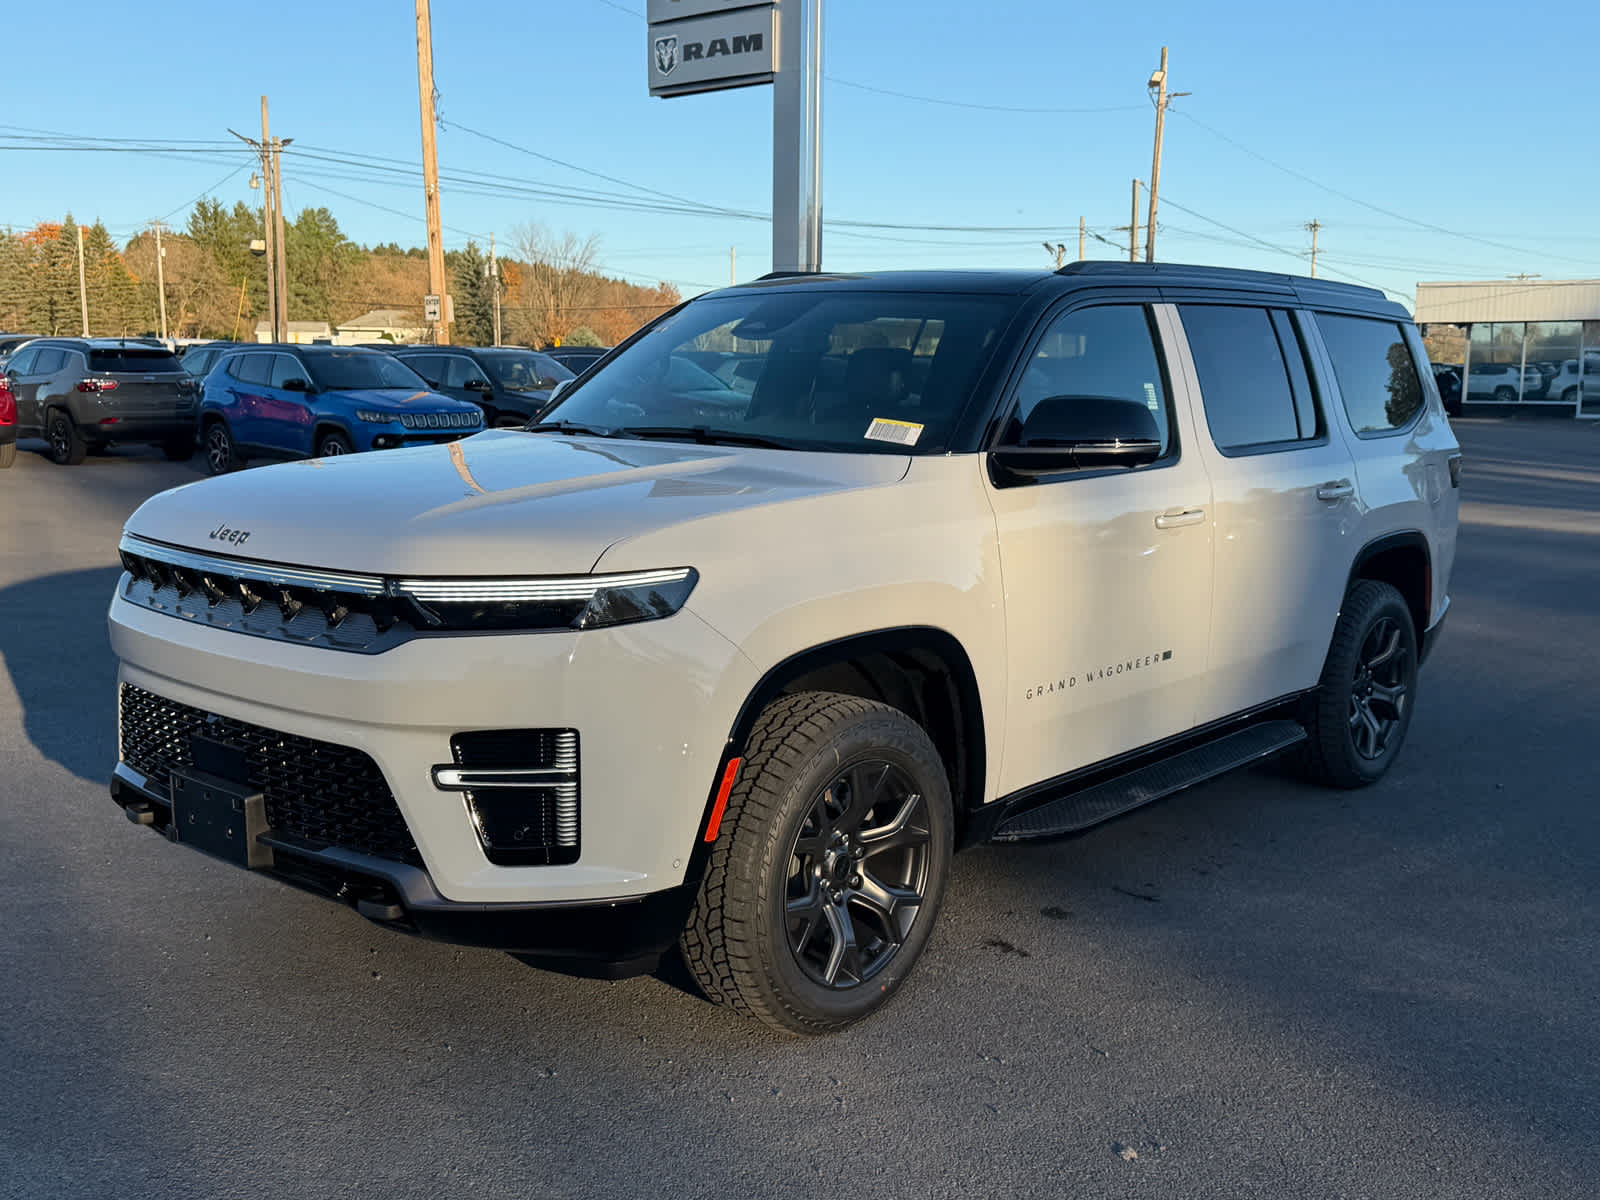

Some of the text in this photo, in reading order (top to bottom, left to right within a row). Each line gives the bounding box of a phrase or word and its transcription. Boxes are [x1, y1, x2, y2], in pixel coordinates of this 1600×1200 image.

[683, 33, 763, 61] RAM
[209, 524, 250, 546] Jeep
[1026, 653, 1160, 700] GRAND WAGONEER
